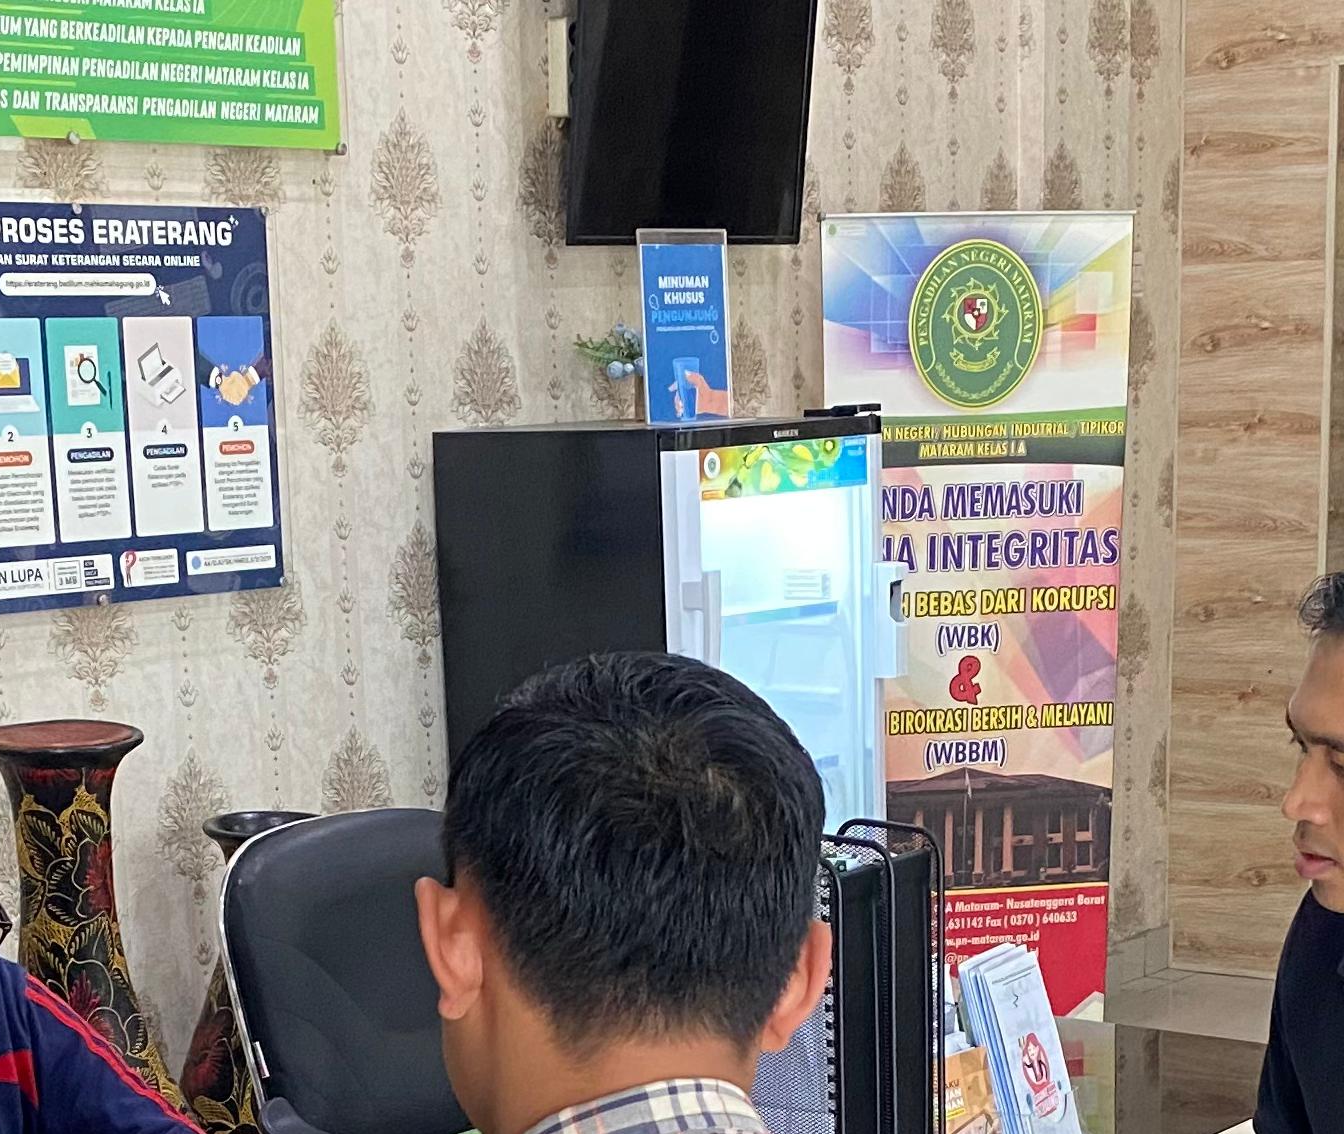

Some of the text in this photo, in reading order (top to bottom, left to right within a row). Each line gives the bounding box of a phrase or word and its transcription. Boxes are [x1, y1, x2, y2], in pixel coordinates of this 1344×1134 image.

[25, 17, 57, 39] YANG
[60, 20, 144, 44] BERKEADILAN
[147, 28, 192, 48] KEPADA
[195, 33, 244, 51] PENCARI
[246, 36, 301, 56] KEADILAN
[82, 60, 158, 81] PENGADILAN
[161, 63, 202, 84] NEGERI
[205, 66, 260, 87] MATARAM
[262, 70, 296, 89] KELAS
[297, 73, 309, 90] IA
[13, 90, 39, 110] DAN
[45, 91, 137, 115] TRANSPARANSI
[143, 97, 216, 119] PENGADILAN
[221, 102, 260, 121] NEGERI
[265, 104, 319, 124] MATARAM
[94, 219, 233, 246] ERATERANG
[15, 254, 48, 266] SURAT
[52, 254, 120, 266] KETERANGAN
[123, 255, 161, 266] SECARA
[164, 256, 200, 267] ONLINE
[960, 249, 1012, 273] NEGERI
[658, 275, 709, 289] MINUMAN
[664, 291, 705, 304] KHUSUS
[918, 259, 958, 346] PENGADILAN
[1009, 271, 1035, 344] MATARAM
[7, 431, 14, 442] 2
[86, 428, 92, 438] 3
[161, 425, 167, 435] 4
[233, 421, 239, 431] 5
[943, 423, 1006, 439] HUBUNGAN
[1011, 422, 1068, 436] INDUTRIAL
[1080, 421, 1124, 435] TIPIKOR
[919, 442, 973, 458] MATARAM
[977, 442, 1008, 457] KELAS
[882, 480, 1085, 523] NDA MEMASUKI
[927, 527, 1120, 573] INTEGRITAS
[10, 568, 43, 584] LUPA
[915, 589, 976, 617] BEBAS
[981, 587, 1025, 615] DARI
[1031, 585, 1116, 612] KORUPSI
[937, 623, 1001, 655] (WBK)
[949, 655, 982, 705] &
[889, 702, 1114, 735] BIROKRASI BERSIH & MELAYANI
[925, 738, 1007, 771] (WBBM)
[985, 915, 1002, 927] Fax
[1042, 911, 1077, 924] 640633
